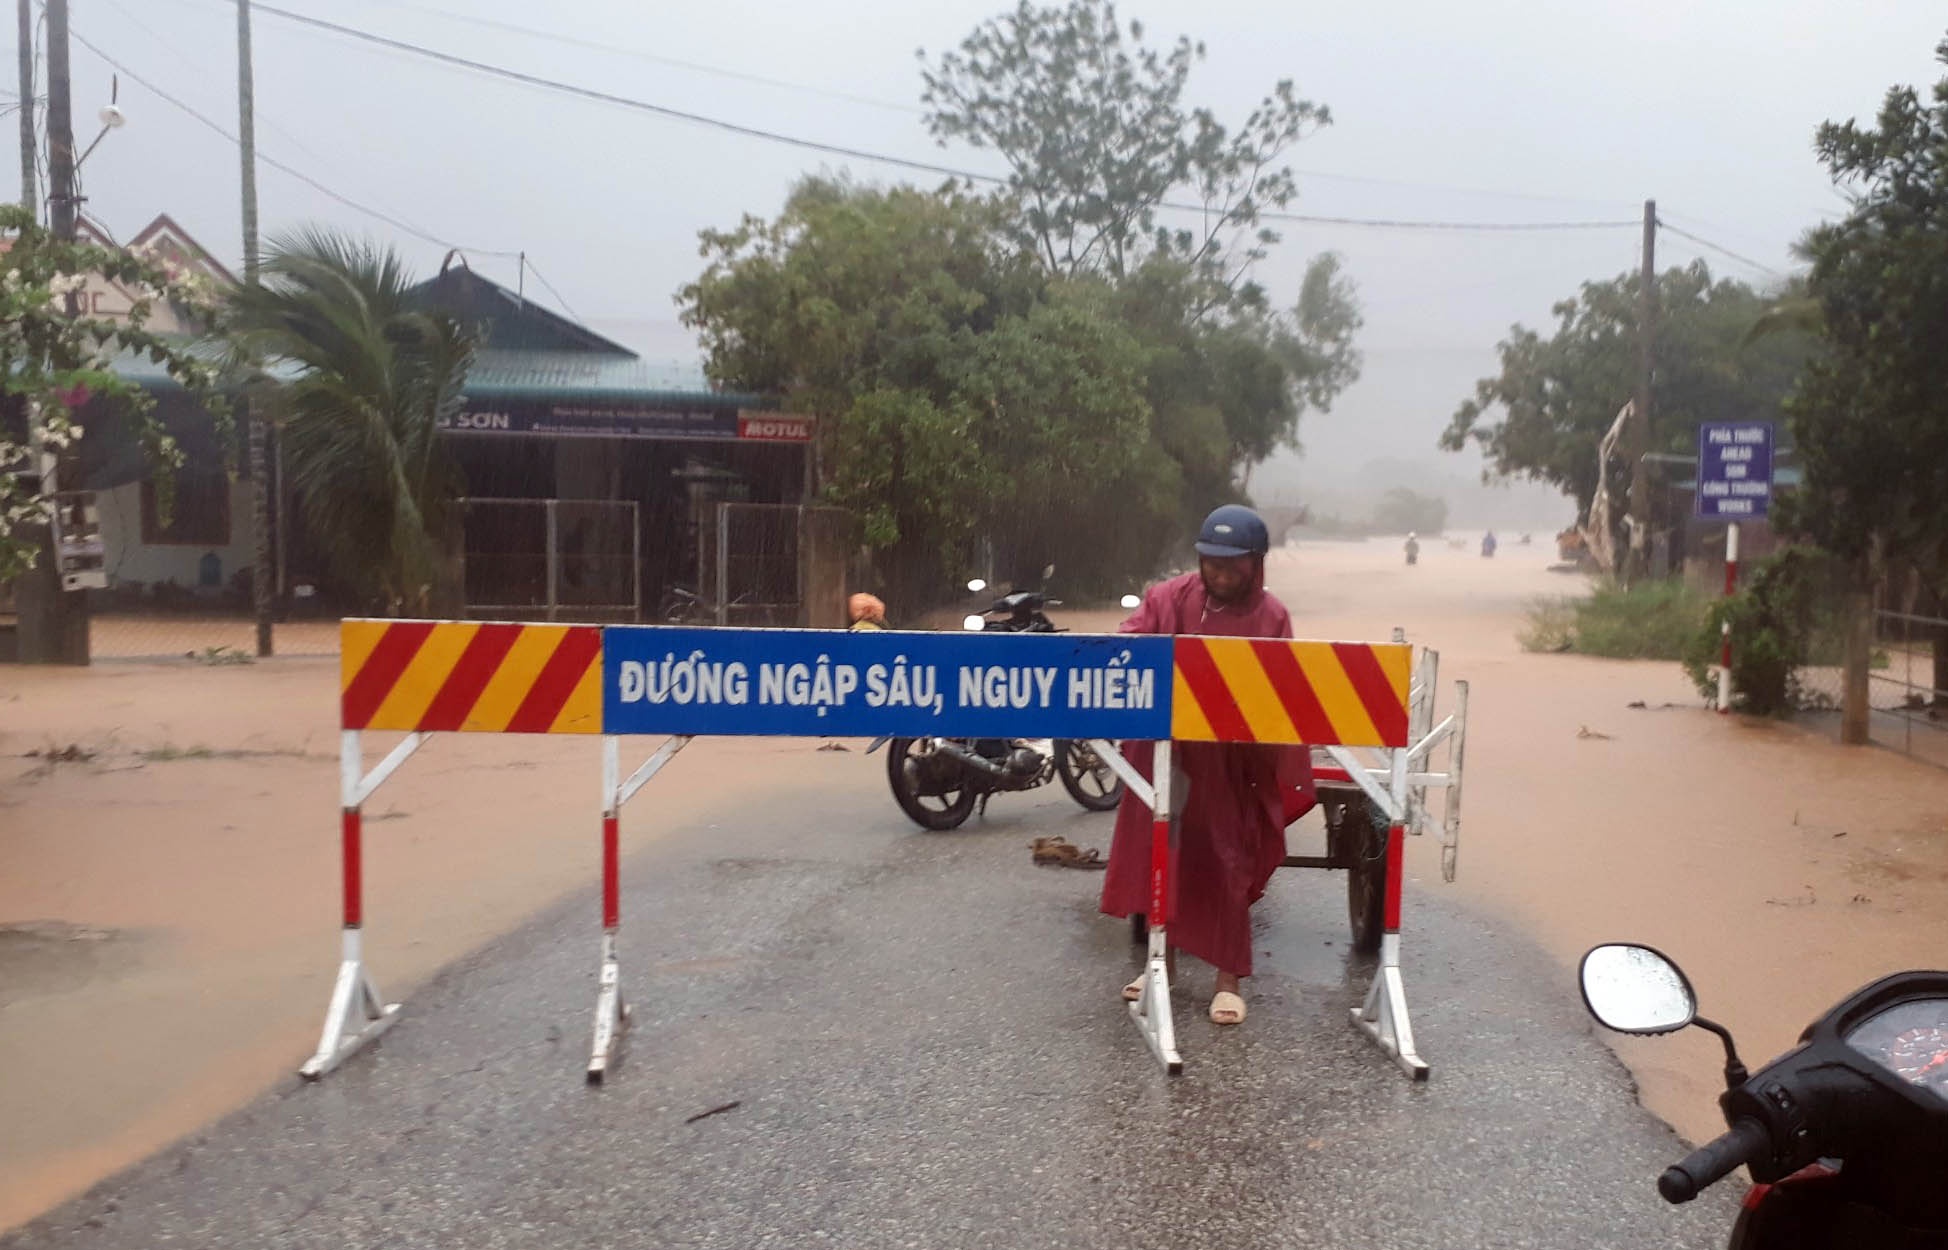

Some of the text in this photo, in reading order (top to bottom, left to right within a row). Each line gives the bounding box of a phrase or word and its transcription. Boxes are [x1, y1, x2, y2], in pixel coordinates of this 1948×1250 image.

[745, 421, 808, 437] MOTUL
[1721, 446, 1752, 462] AHEAD
[1718, 499, 1752, 513] WORKS
[759, 654, 858, 716] NGẬP
[865, 655, 944, 716] SÂU,
[958, 665, 1058, 709] NGUY
[1067, 650, 1154, 709] HIỂM
